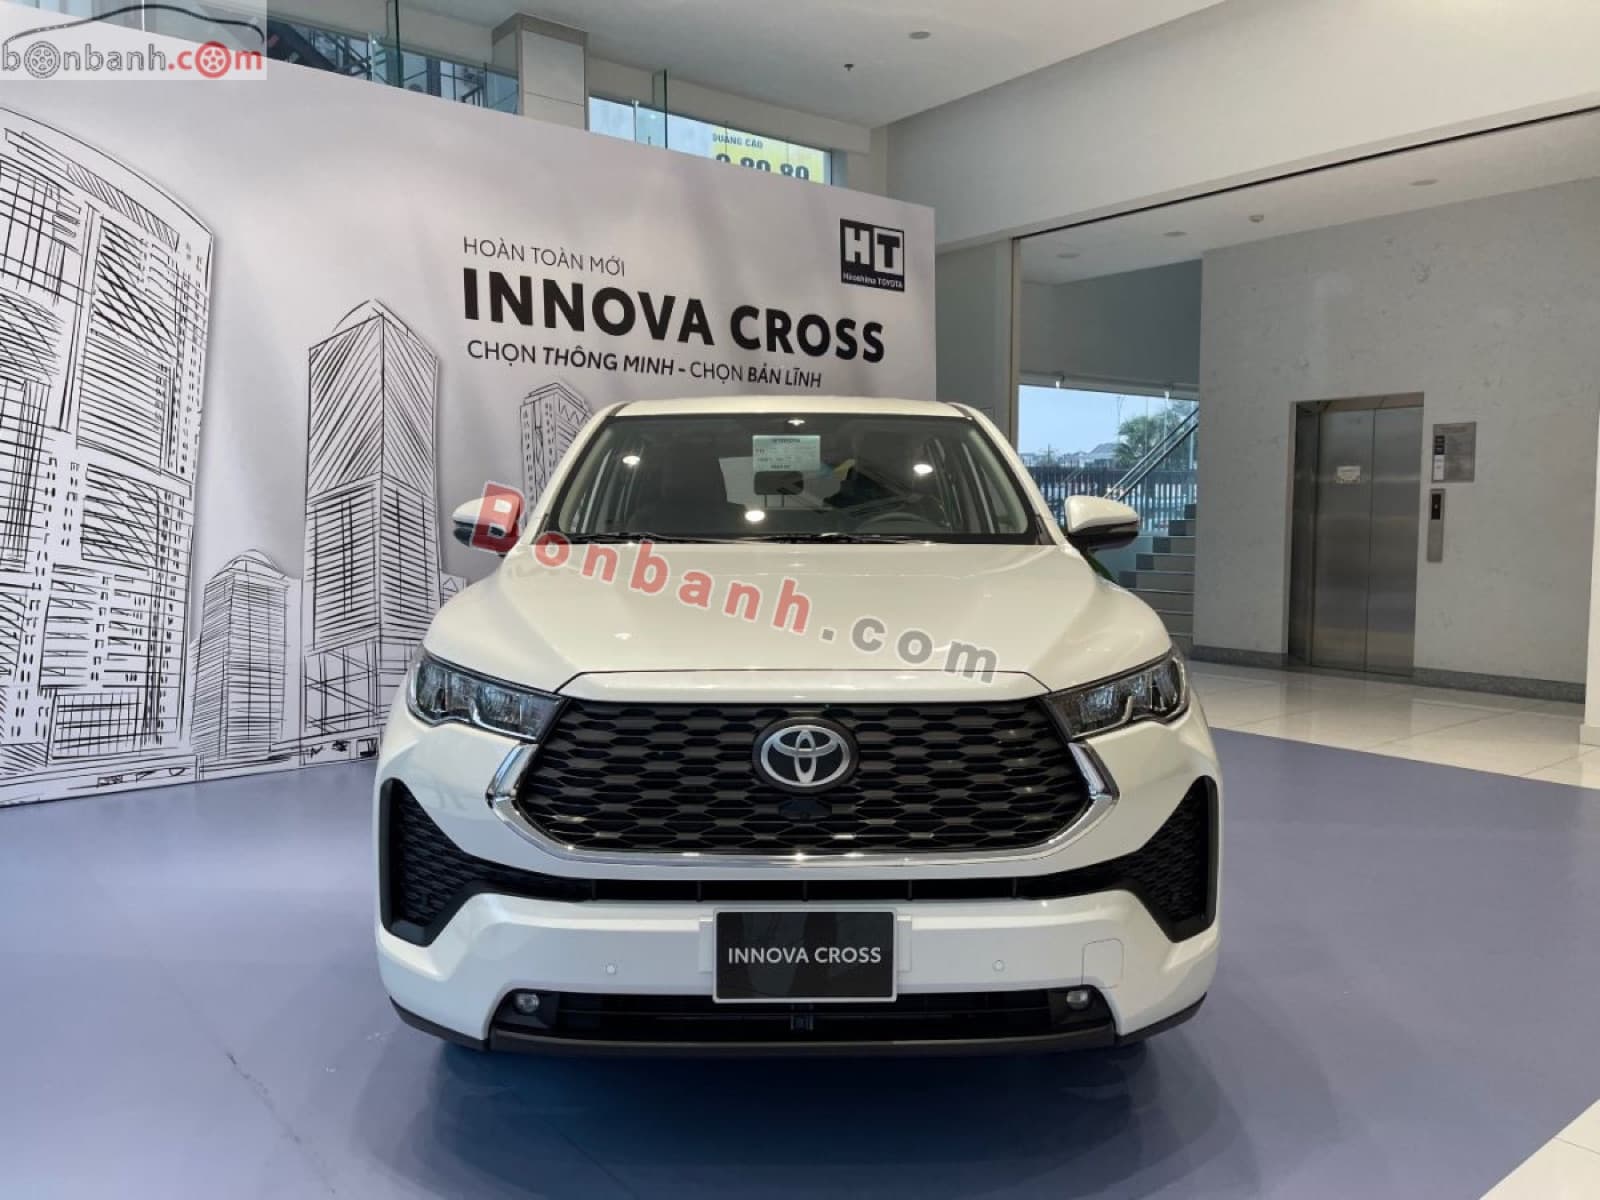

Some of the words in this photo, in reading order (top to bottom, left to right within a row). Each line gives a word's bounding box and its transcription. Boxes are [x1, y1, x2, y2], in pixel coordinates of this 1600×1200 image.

[463, 235, 525, 262] HOÀN
[530, 246, 585, 271] TOÀN
[590, 255, 625, 277] MỚI
[844, 226, 900, 269] HT
[463, 268, 715, 346] INNOVA
[730, 304, 885, 363] CROSS
[467, 339, 537, 367] CHỌN
[542, 345, 618, 371] THÔNG
[623, 354, 675, 376] MINH
[689, 361, 744, 385] CHỌN
[747, 362, 781, 385] BẢN
[784, 367, 822, 388] LĨNH
[728, 947, 810, 964] INNOVA
[814, 947, 882, 964] CROSS
